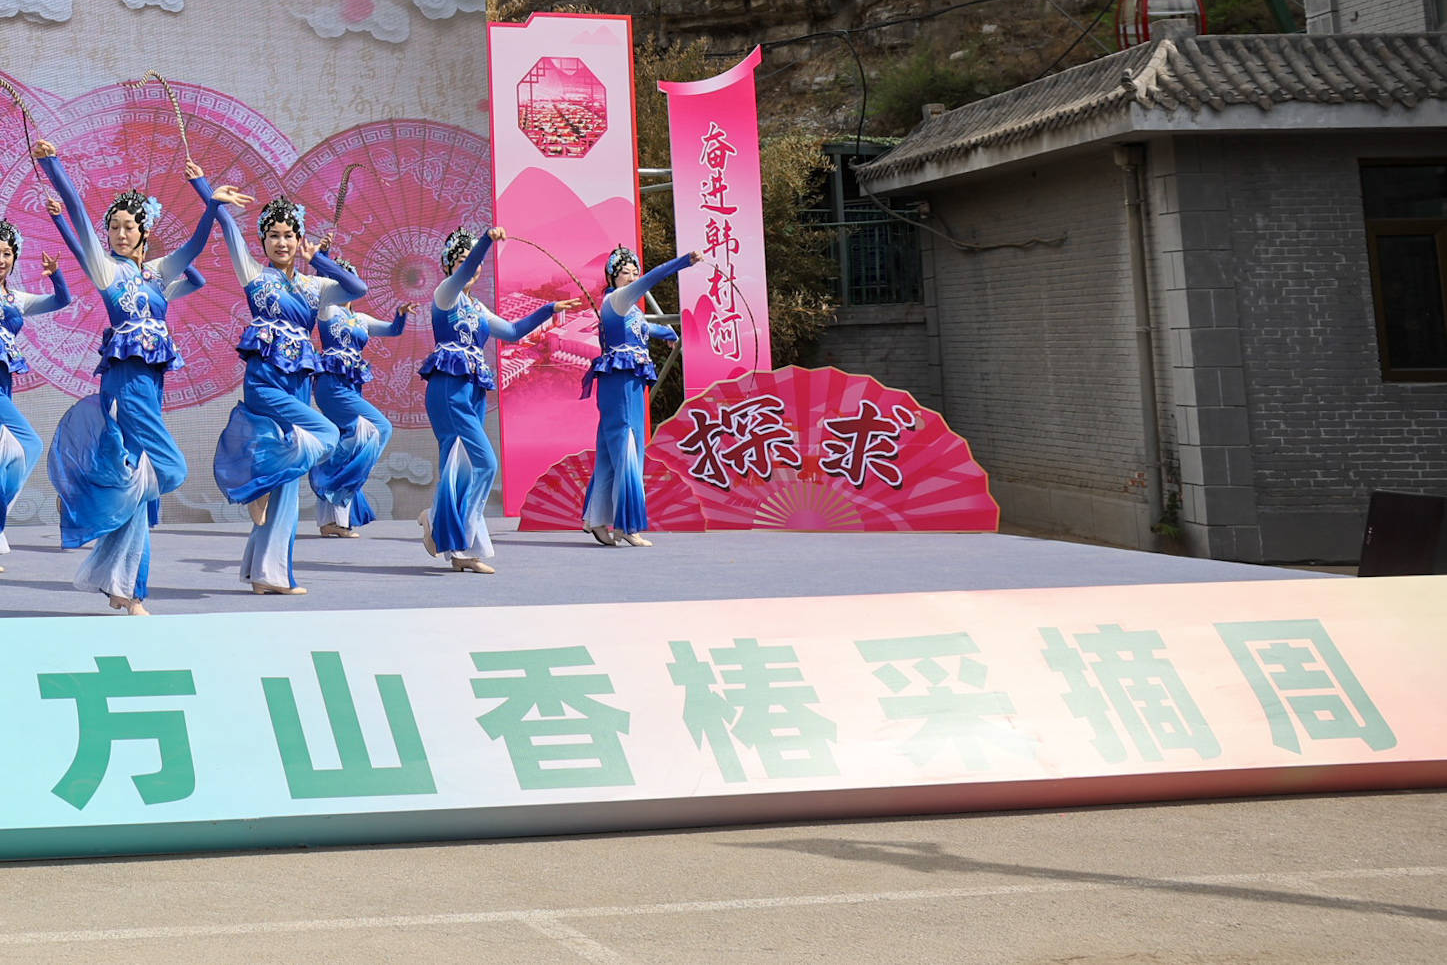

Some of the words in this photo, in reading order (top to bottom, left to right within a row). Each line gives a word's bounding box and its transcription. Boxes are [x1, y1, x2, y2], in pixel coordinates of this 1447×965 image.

[699, 122, 741, 361] 奋进韩村河
[679, 394, 917, 490] 探求
